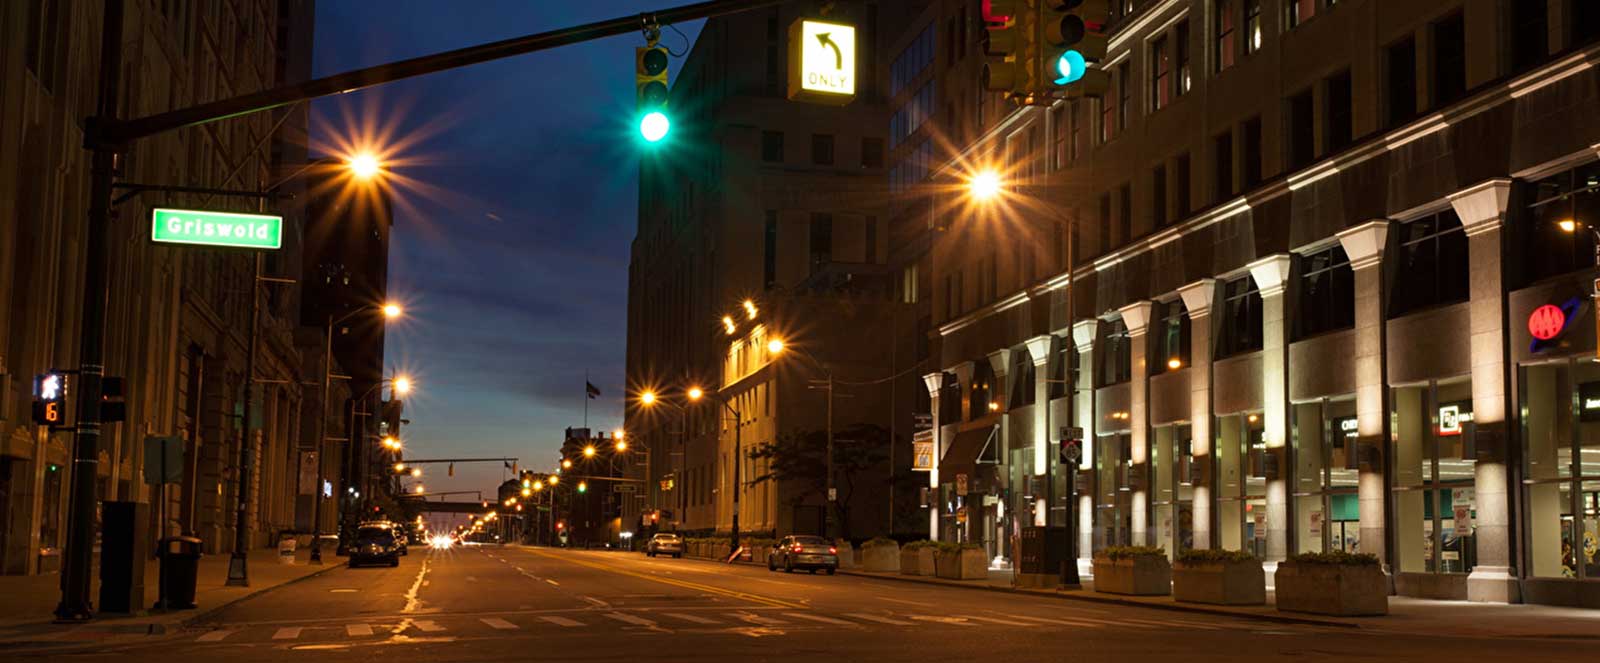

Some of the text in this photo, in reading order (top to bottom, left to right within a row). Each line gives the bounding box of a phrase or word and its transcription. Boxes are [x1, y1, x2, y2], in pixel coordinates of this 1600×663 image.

[808, 72, 847, 88] ONLY
[167, 216, 269, 240] Griswold
[1530, 305, 1564, 338] AAA
